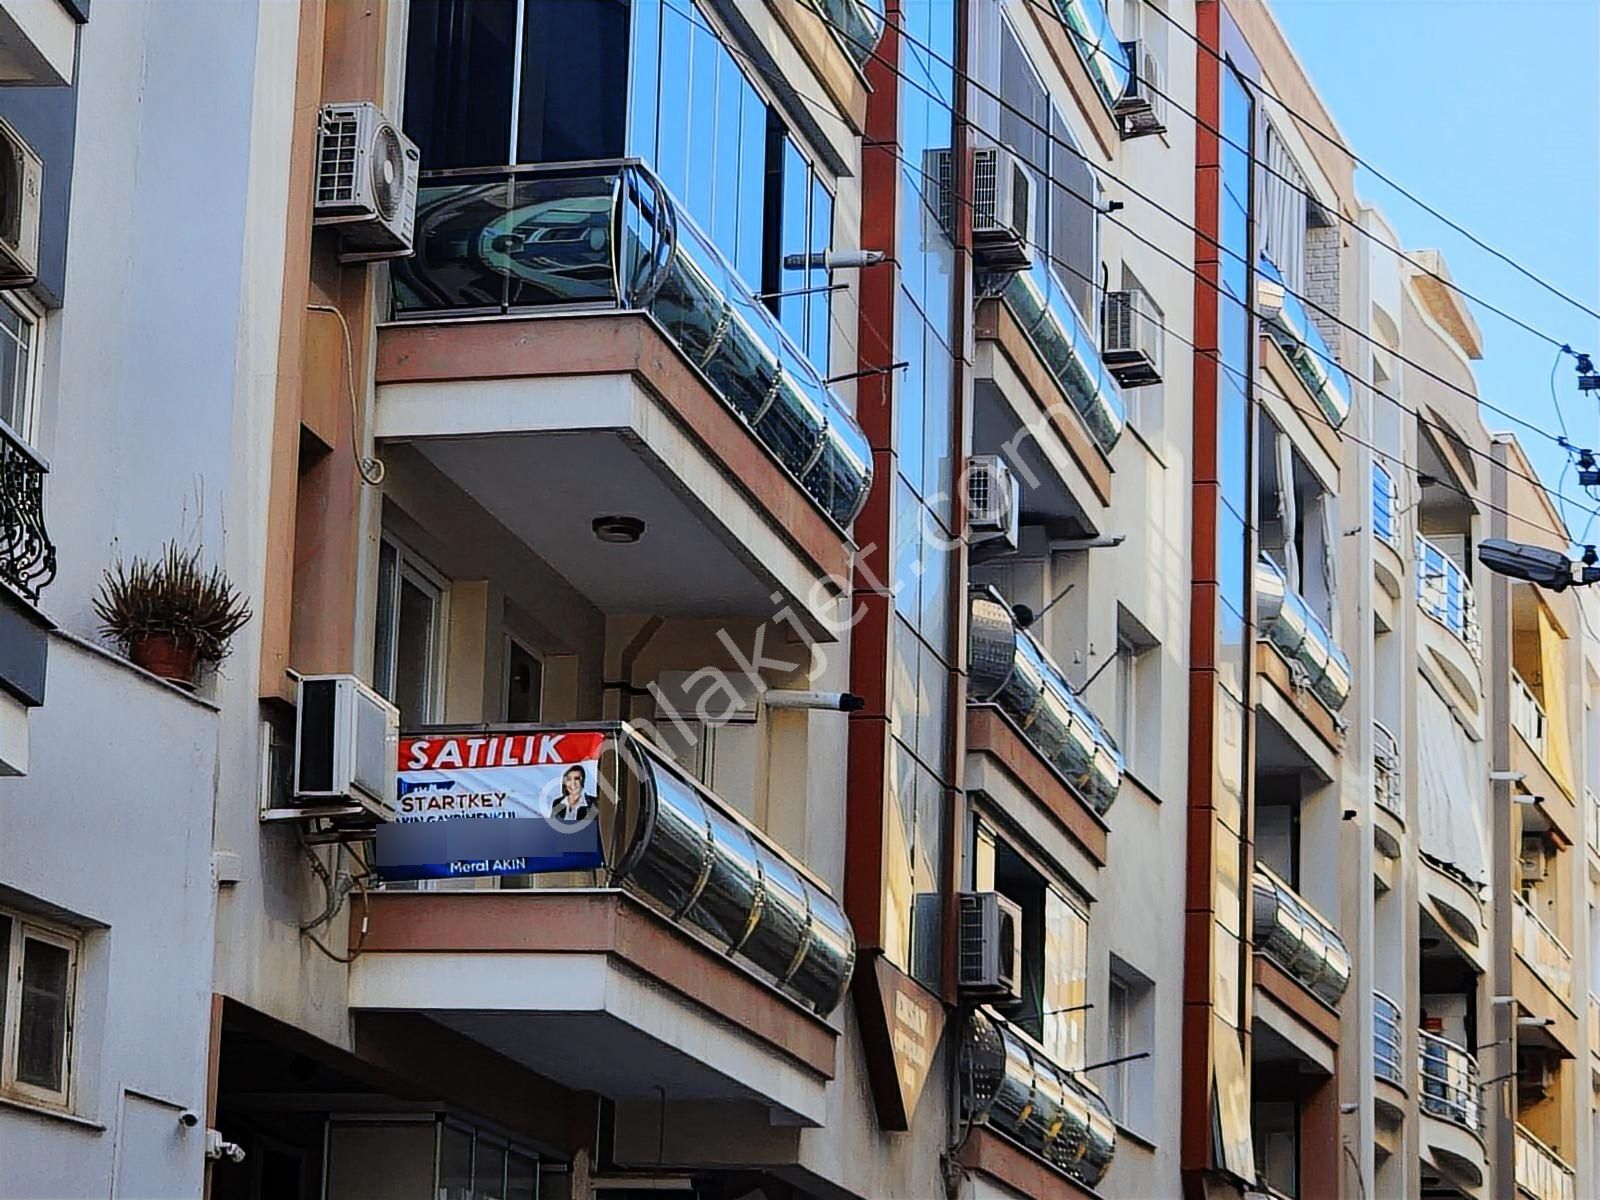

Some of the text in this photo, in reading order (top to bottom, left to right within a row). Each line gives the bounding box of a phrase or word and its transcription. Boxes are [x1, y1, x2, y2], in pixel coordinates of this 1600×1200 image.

[407, 734, 566, 770] SATILIK
[402, 792, 506, 812] STARTKEY
[450, 858, 526, 873] Meral AKIN
